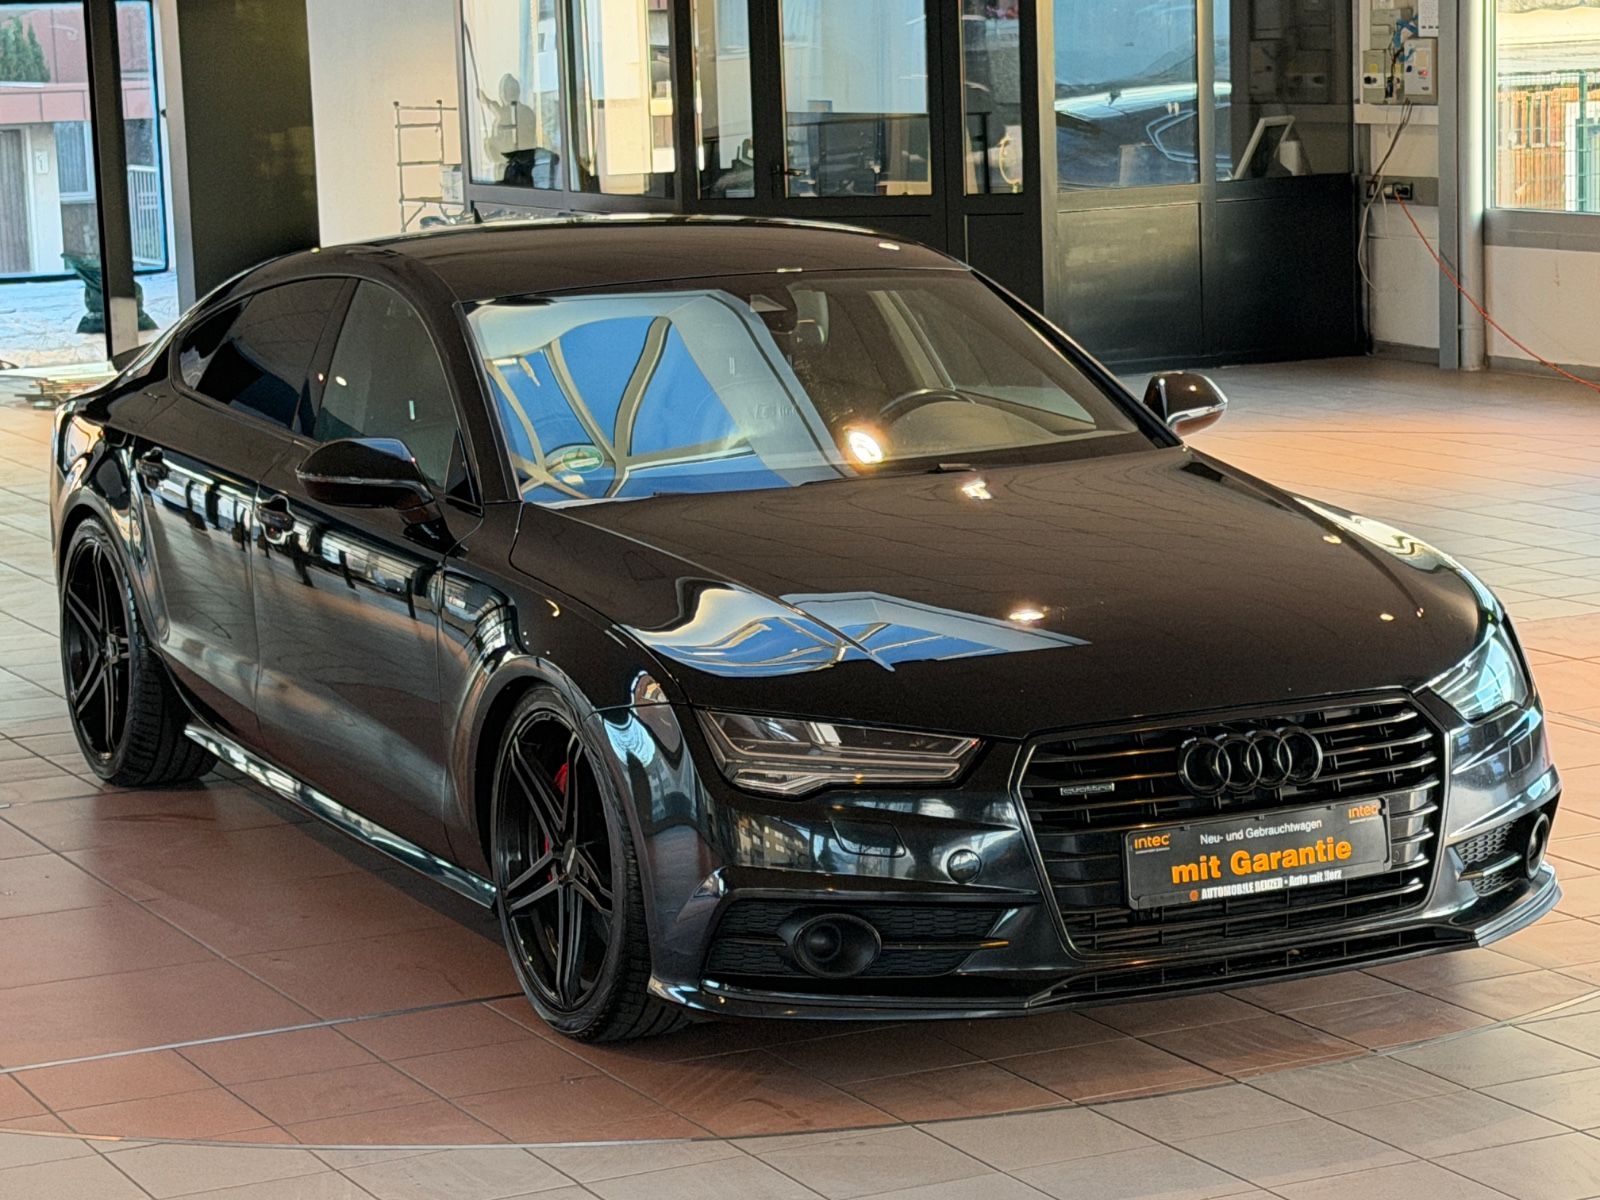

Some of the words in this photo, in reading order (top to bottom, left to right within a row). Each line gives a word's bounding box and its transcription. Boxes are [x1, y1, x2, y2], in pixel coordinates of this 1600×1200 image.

[1134, 833, 1170, 849] intec
[1200, 833, 1224, 845] Neu-
[1225, 829, 1244, 842] und
[1245, 819, 1322, 839] Gebrauchtwagen
[1171, 855, 1221, 884] mit
[1230, 836, 1352, 875] Garantie
